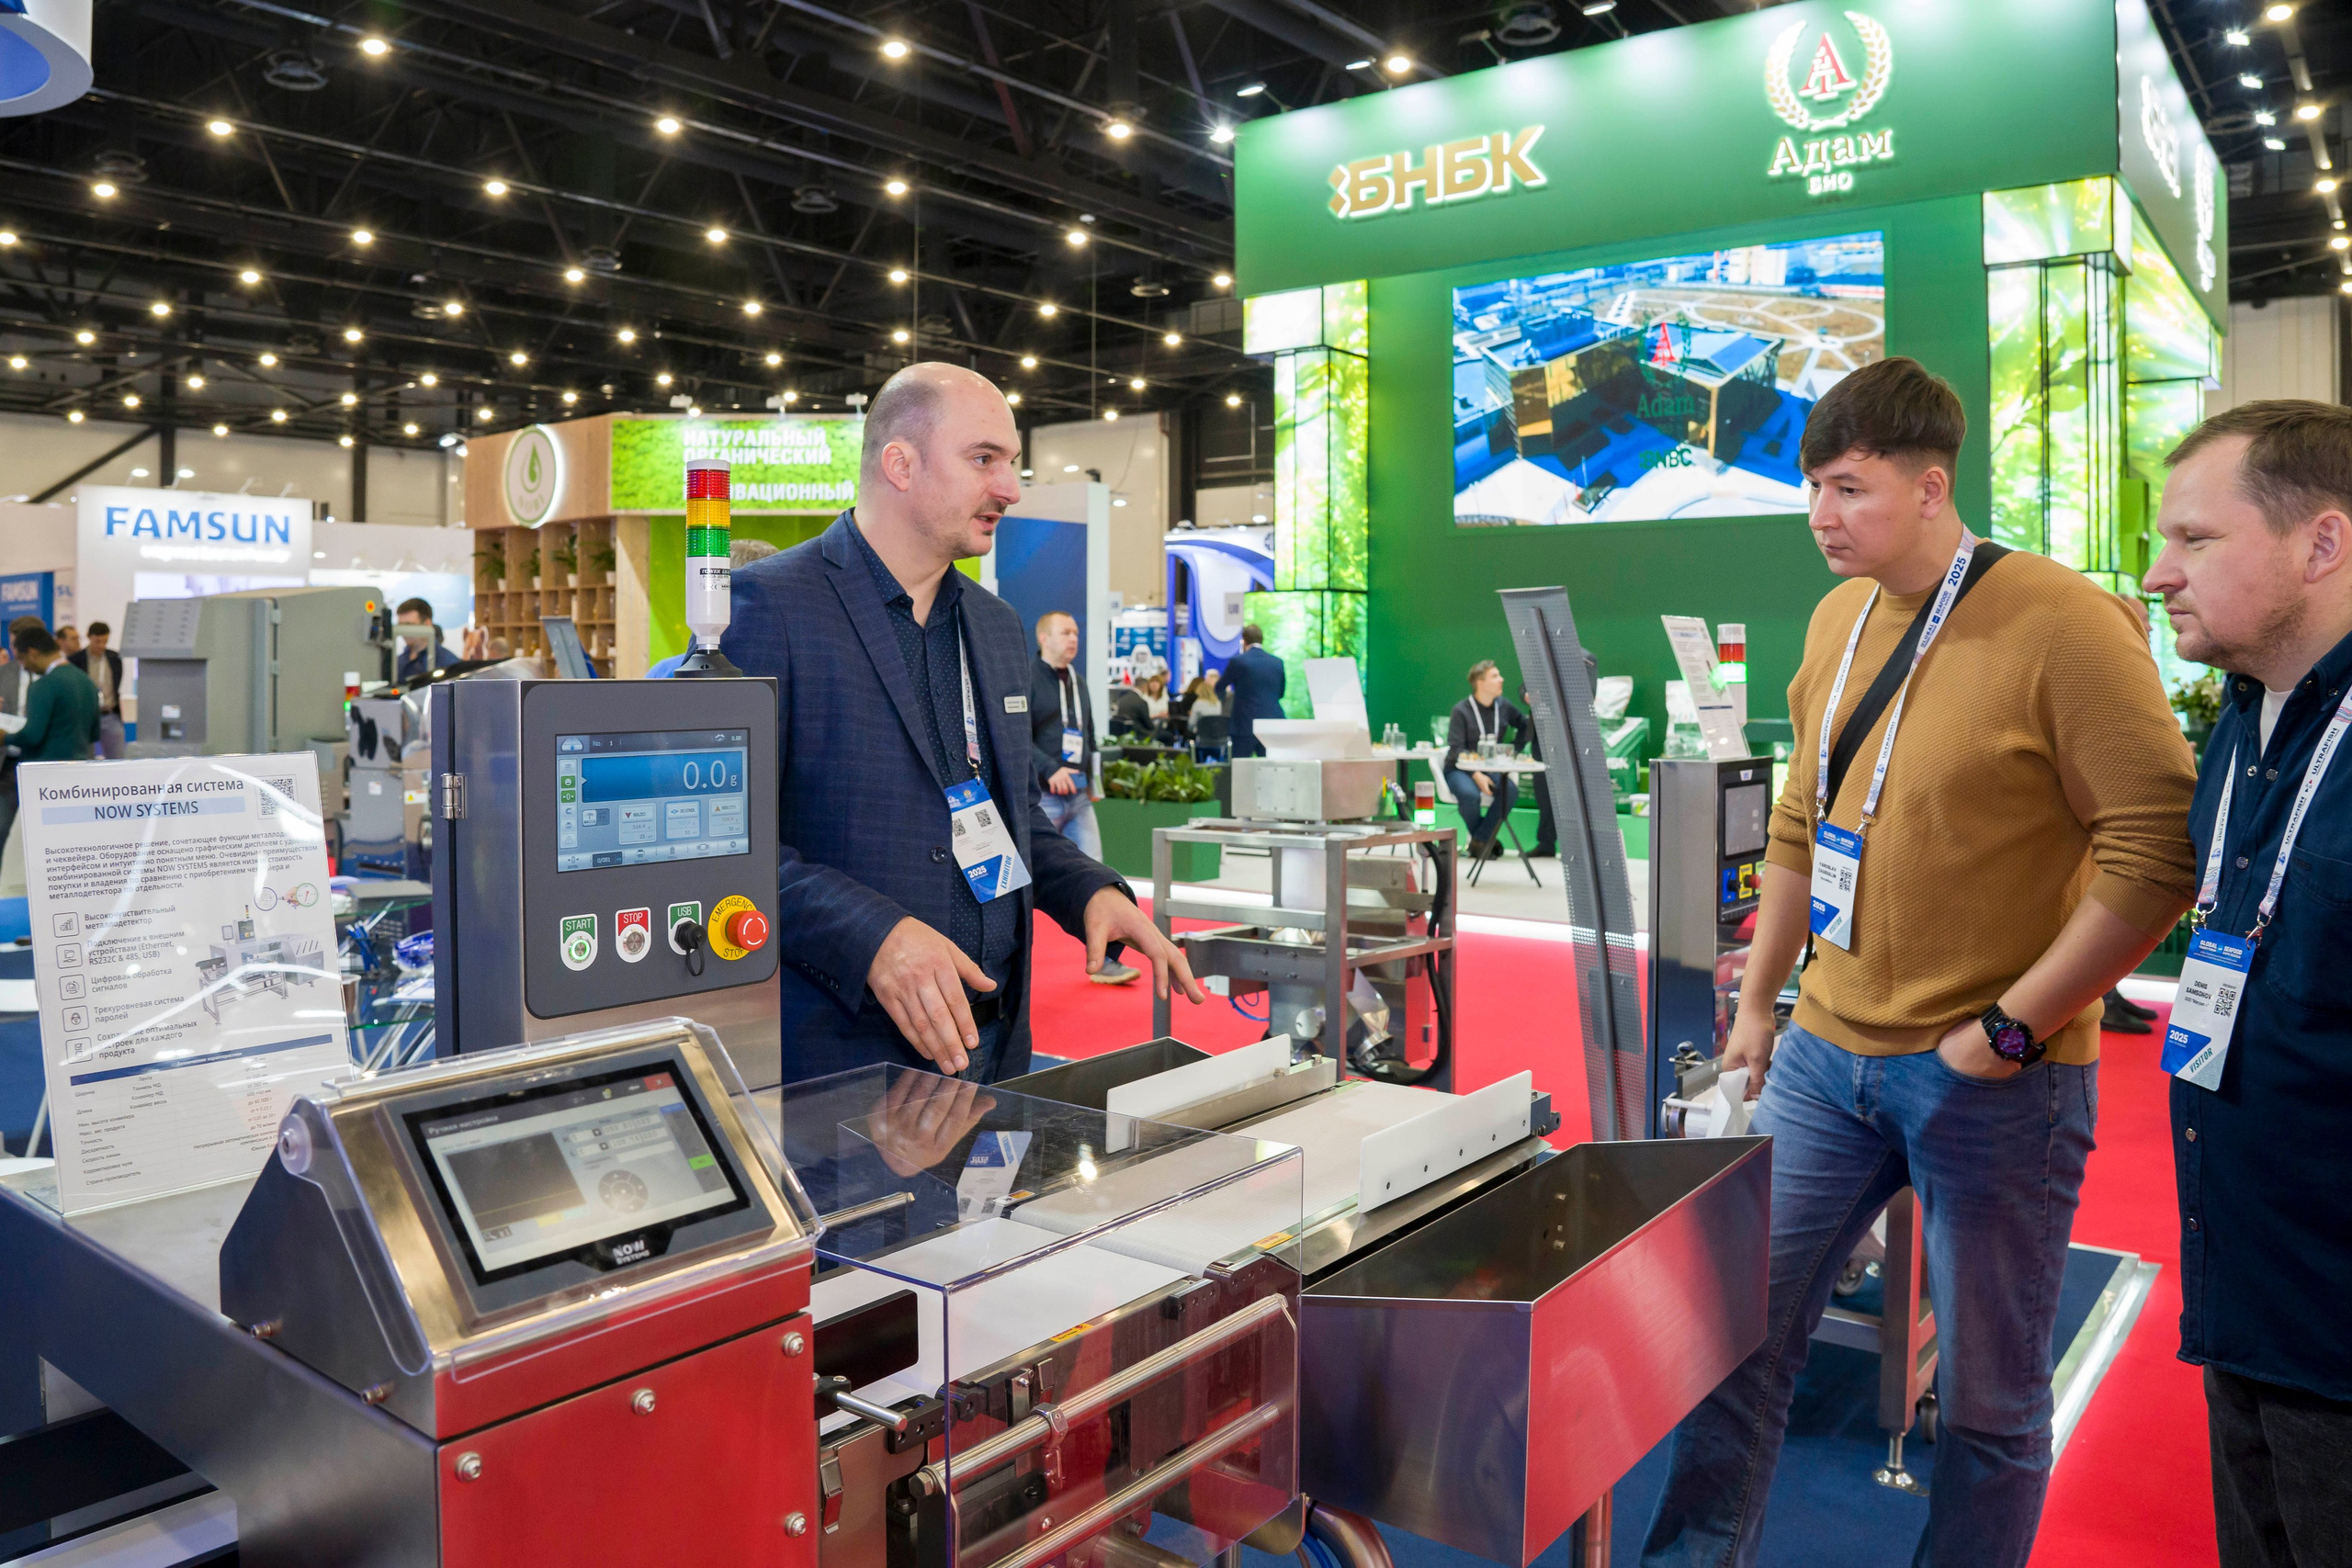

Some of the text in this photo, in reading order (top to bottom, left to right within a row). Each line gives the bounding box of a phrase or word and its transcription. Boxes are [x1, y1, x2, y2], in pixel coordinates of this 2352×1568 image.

[1767, 129, 1894, 176] Адам
[1348, 123, 1548, 218] БНБК
[1636, 393, 1695, 418] Adam
[106, 506, 289, 544] FAMSUN
[1948, 557, 1966, 587] 2025
[1935, 591, 1949, 615] SEAFOOD
[1920, 625, 1935, 648] GLOBAL
[1882, 721, 1895, 759] ULTRAFISH
[2312, 728, 2338, 775] ULTRAFISH
[683, 760, 737, 790] 0.0 g
[39, 780, 244, 800] Комбинированная система
[94, 801, 198, 820] NOW SYSTEMS
[2285, 796, 2305, 845] ULTRAFISH
[45, 842, 133, 855] Высокотехнологичное
[172, 836, 218, 846] сочетающее
[219, 833, 250, 844] функции
[53, 853, 97, 864] чеквейера.
[99, 851, 155, 862] Оборудование
[157, 847, 194, 855] оснащено
[195, 843, 243, 854] графическим
[244, 840, 278, 850] дисплеем
[47, 863, 101, 874] интерфейсом
[156, 855, 193, 864] понятным
[195, 852, 218, 861] меню.
[263, 845, 318, 857] преимуществом
[47, 854, 303, 882] комбинированной системы NOW SYSTEMS является стоимость
[48, 883, 82, 891] покупки
[90, 879, 128, 888] владения
[141, 874, 183, 884] сравнению
[189, 868, 246, 879] приобретением
[967, 864, 987, 878] 2025
[1001, 855, 1012, 889] EXHIBITOR
[49, 886, 122, 900] металлодетектора
[135, 883, 185, 893] отдельности.
[85, 906, 176, 920] Высокочувствительный
[677, 907, 692, 918] USB
[1812, 899, 1826, 912] 2025
[85, 918, 153, 931] металлодетектор
[566, 919, 592, 931] START
[623, 912, 643, 924] STOP
[1828, 916, 1843, 935] VISITOR
[87, 935, 141, 948] Подключение
[149, 931, 186, 940] внешним
[2199, 940, 2244, 955] GLOBAL SEAFOOD
[88, 942, 175, 958] устройствам (Ethernet,
[89, 956, 117, 965] RS232C
[142, 951, 161, 959] USB)
[90, 967, 173, 985] Цифровая обработка
[2194, 980, 2208, 990] DENIS
[92, 983, 128, 993] сигналов
[2186, 987, 2212, 1000] SAMSONOV
[94, 996, 185, 1014] Трехуровневая система
[96, 1011, 129, 1023] паролей
[145, 1021, 198, 1034] оптимальных
[2169, 1029, 2188, 1044] 2025
[135, 1032, 183, 1045] для каждого
[98, 1047, 136, 1059] продукта
[2189, 1047, 2213, 1073] VISITOR
[612, 1239, 645, 1257] NOW
[616, 1249, 650, 1265] SYSTEMS
